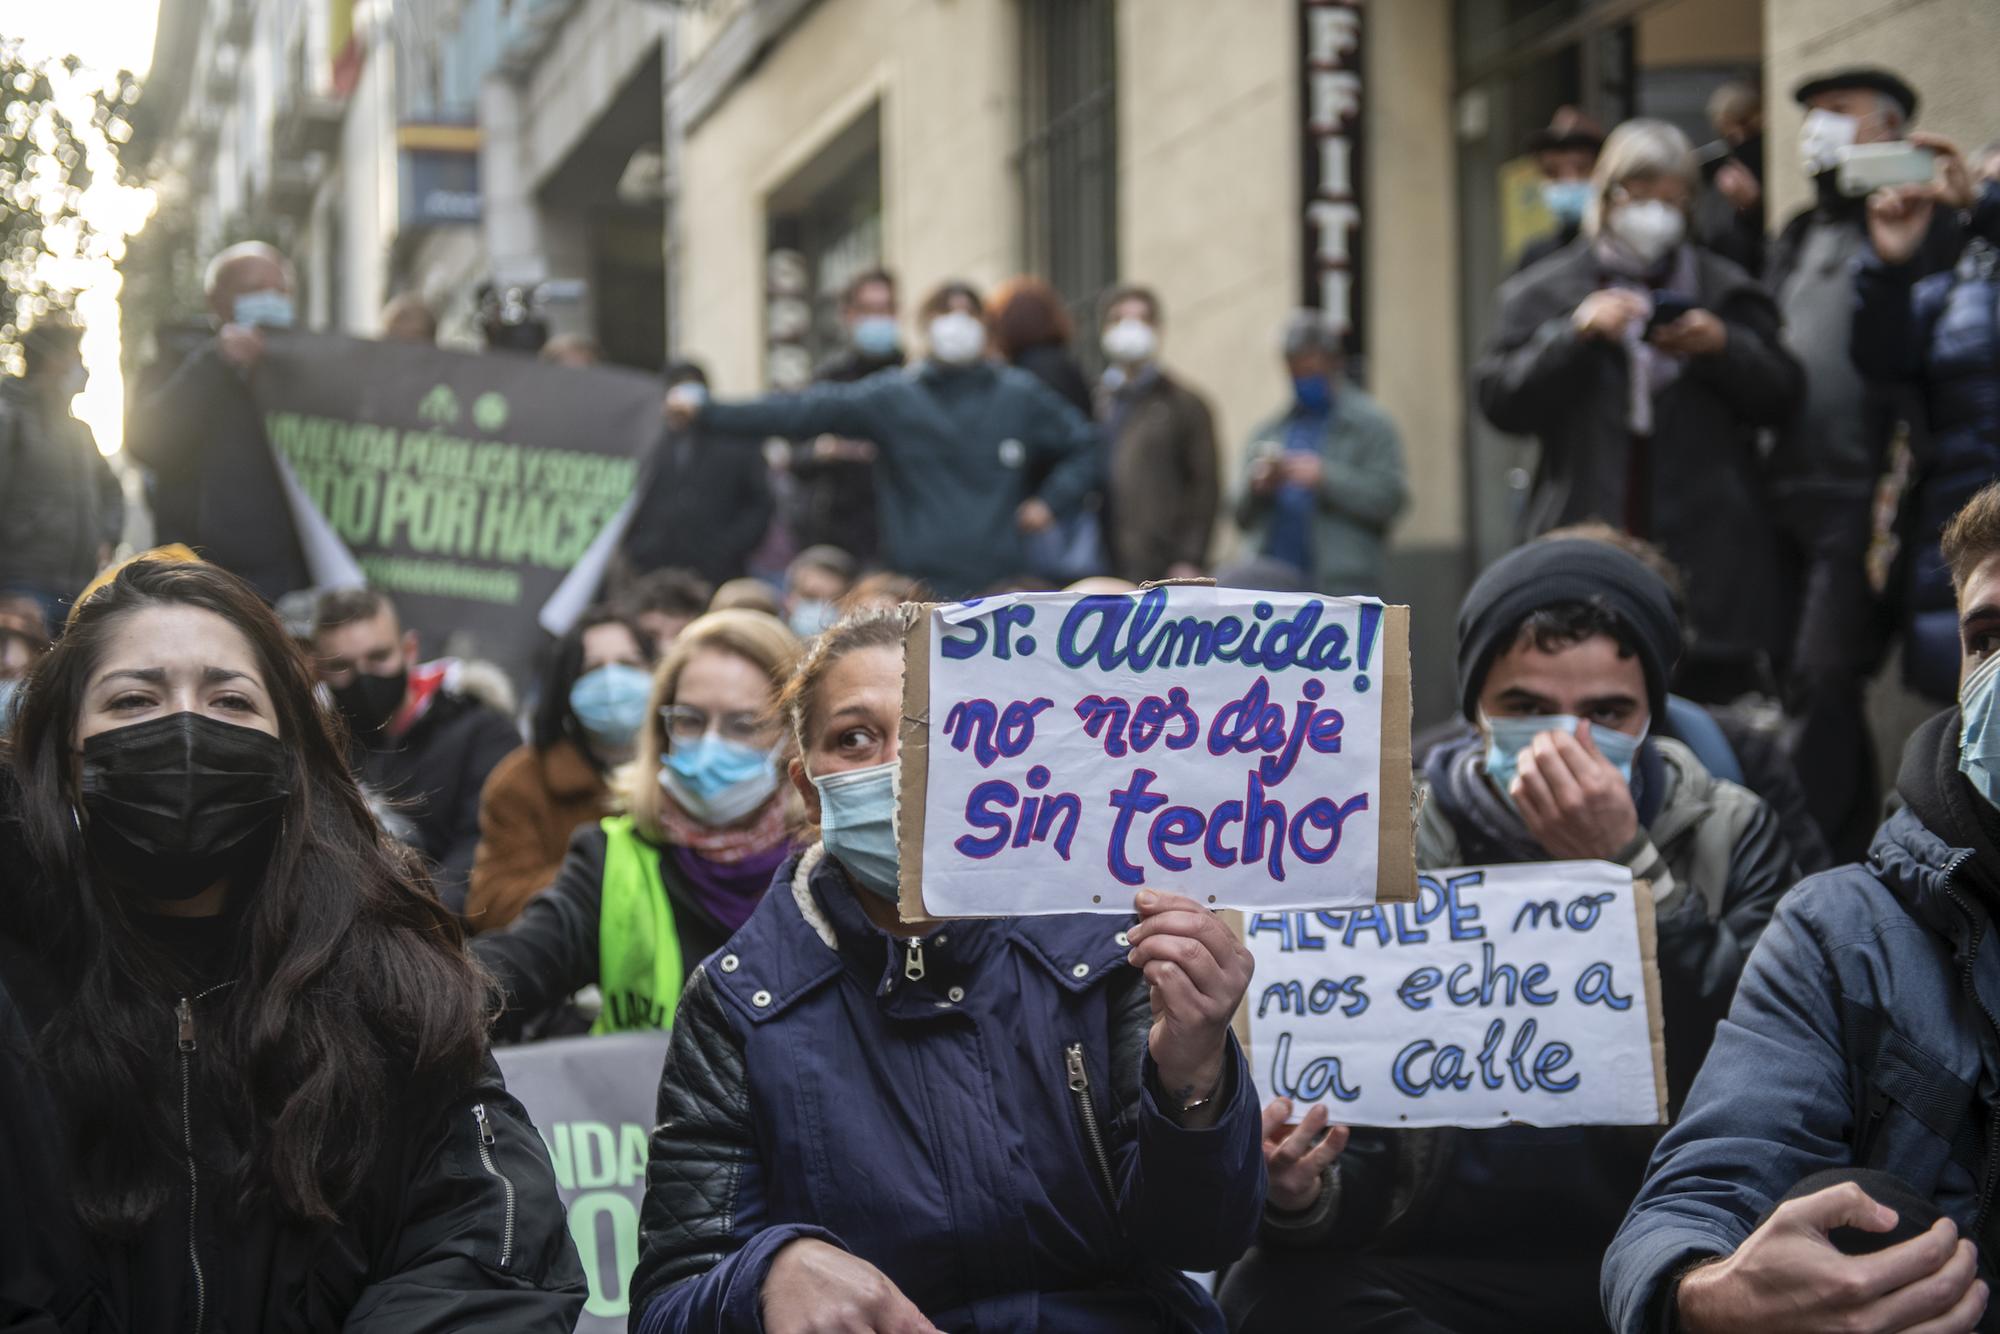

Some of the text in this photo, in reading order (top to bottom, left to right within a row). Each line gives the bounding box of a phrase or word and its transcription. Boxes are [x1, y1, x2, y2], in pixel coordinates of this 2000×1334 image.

[1306, 3, 1361, 333] FFITI
[378, 471, 479, 556] POR
[943, 675, 1344, 787] no nos deje
[1107, 767, 1369, 886] techo
[1397, 942, 1558, 1010] eche
[1575, 961, 1634, 1011] a
[1391, 1018, 1581, 1098] calle
[547, 1121, 649, 1190] NDA
